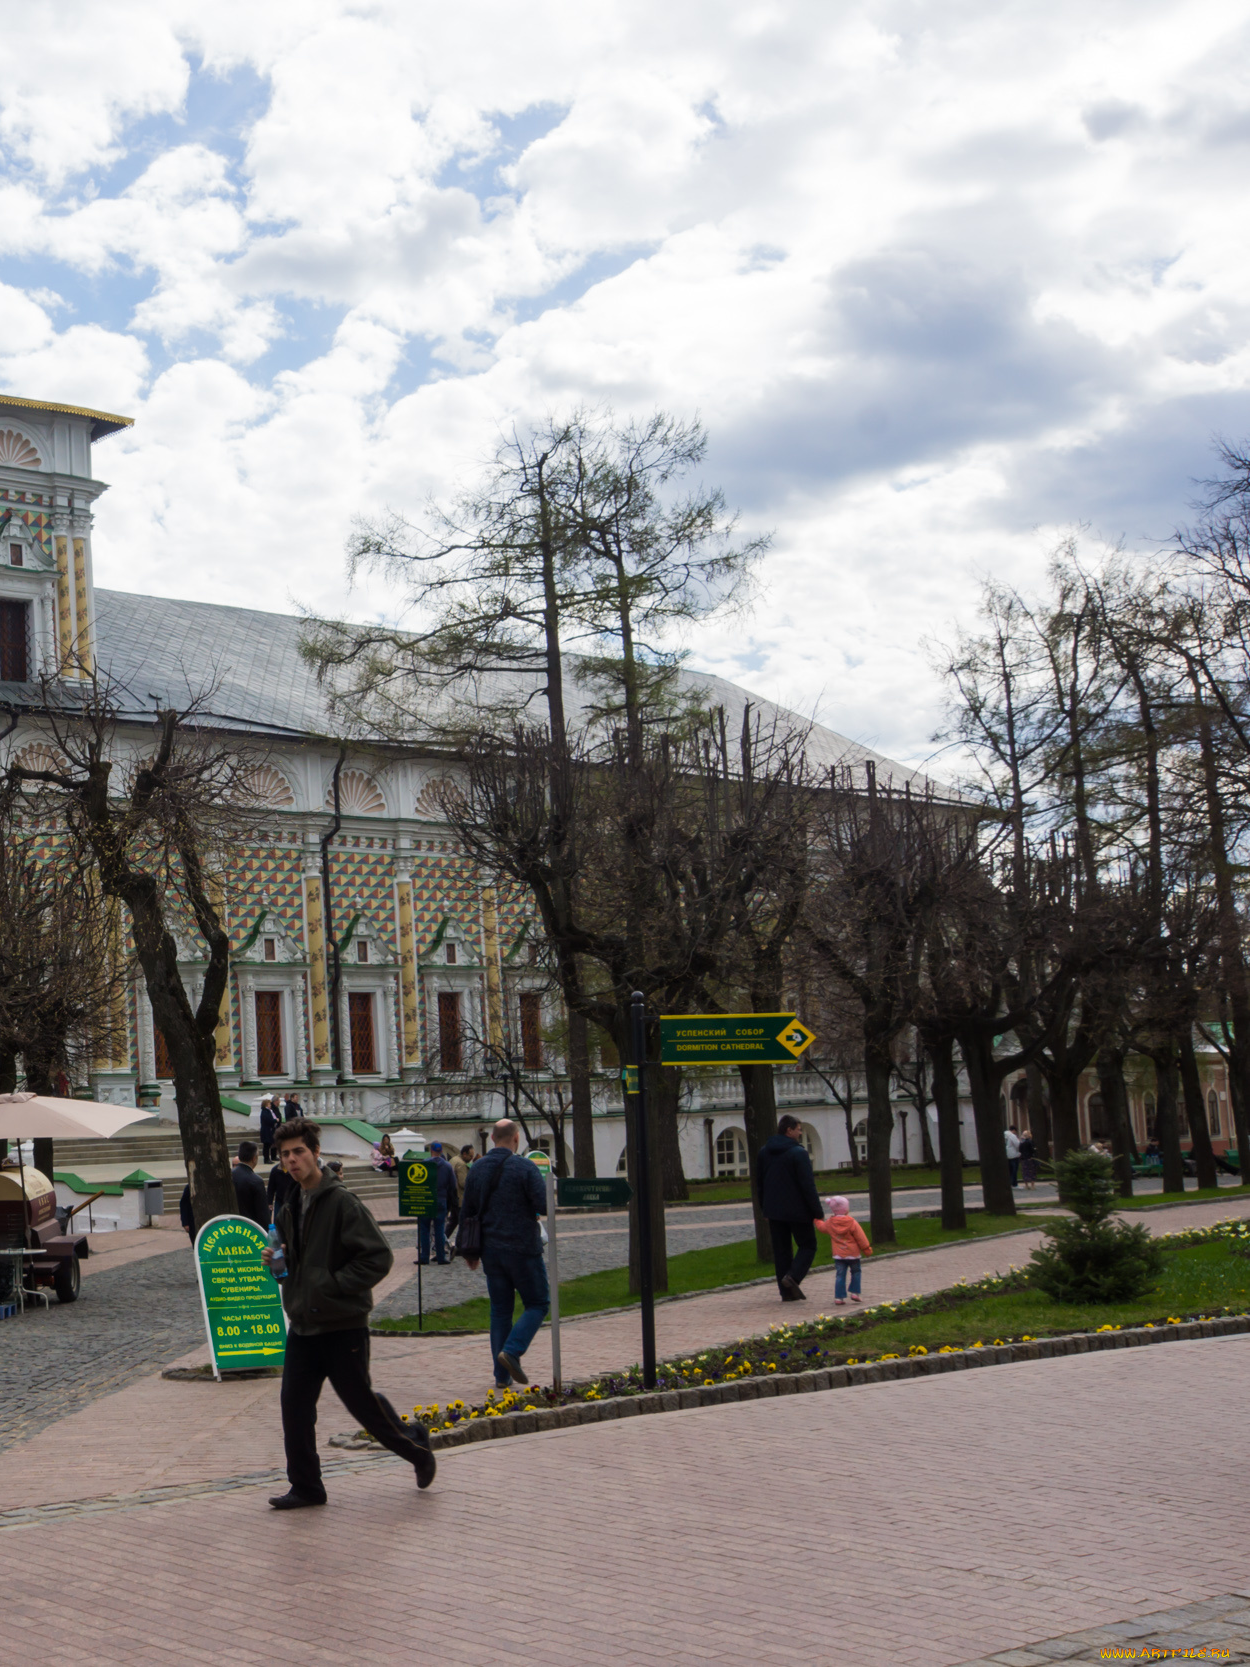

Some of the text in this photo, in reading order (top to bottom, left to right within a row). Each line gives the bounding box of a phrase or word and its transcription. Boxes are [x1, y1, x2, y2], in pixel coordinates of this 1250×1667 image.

[676, 1028, 765, 1037] УСПЕНСКИЙ СОБОР
[203, 1225, 265, 1252] ЦЕРКОВНАЯ
[217, 1246, 253, 1255] ЛАВКА
[217, 1326, 240, 1336] 8.00
[251, 1324, 280, 1334] 18.00
